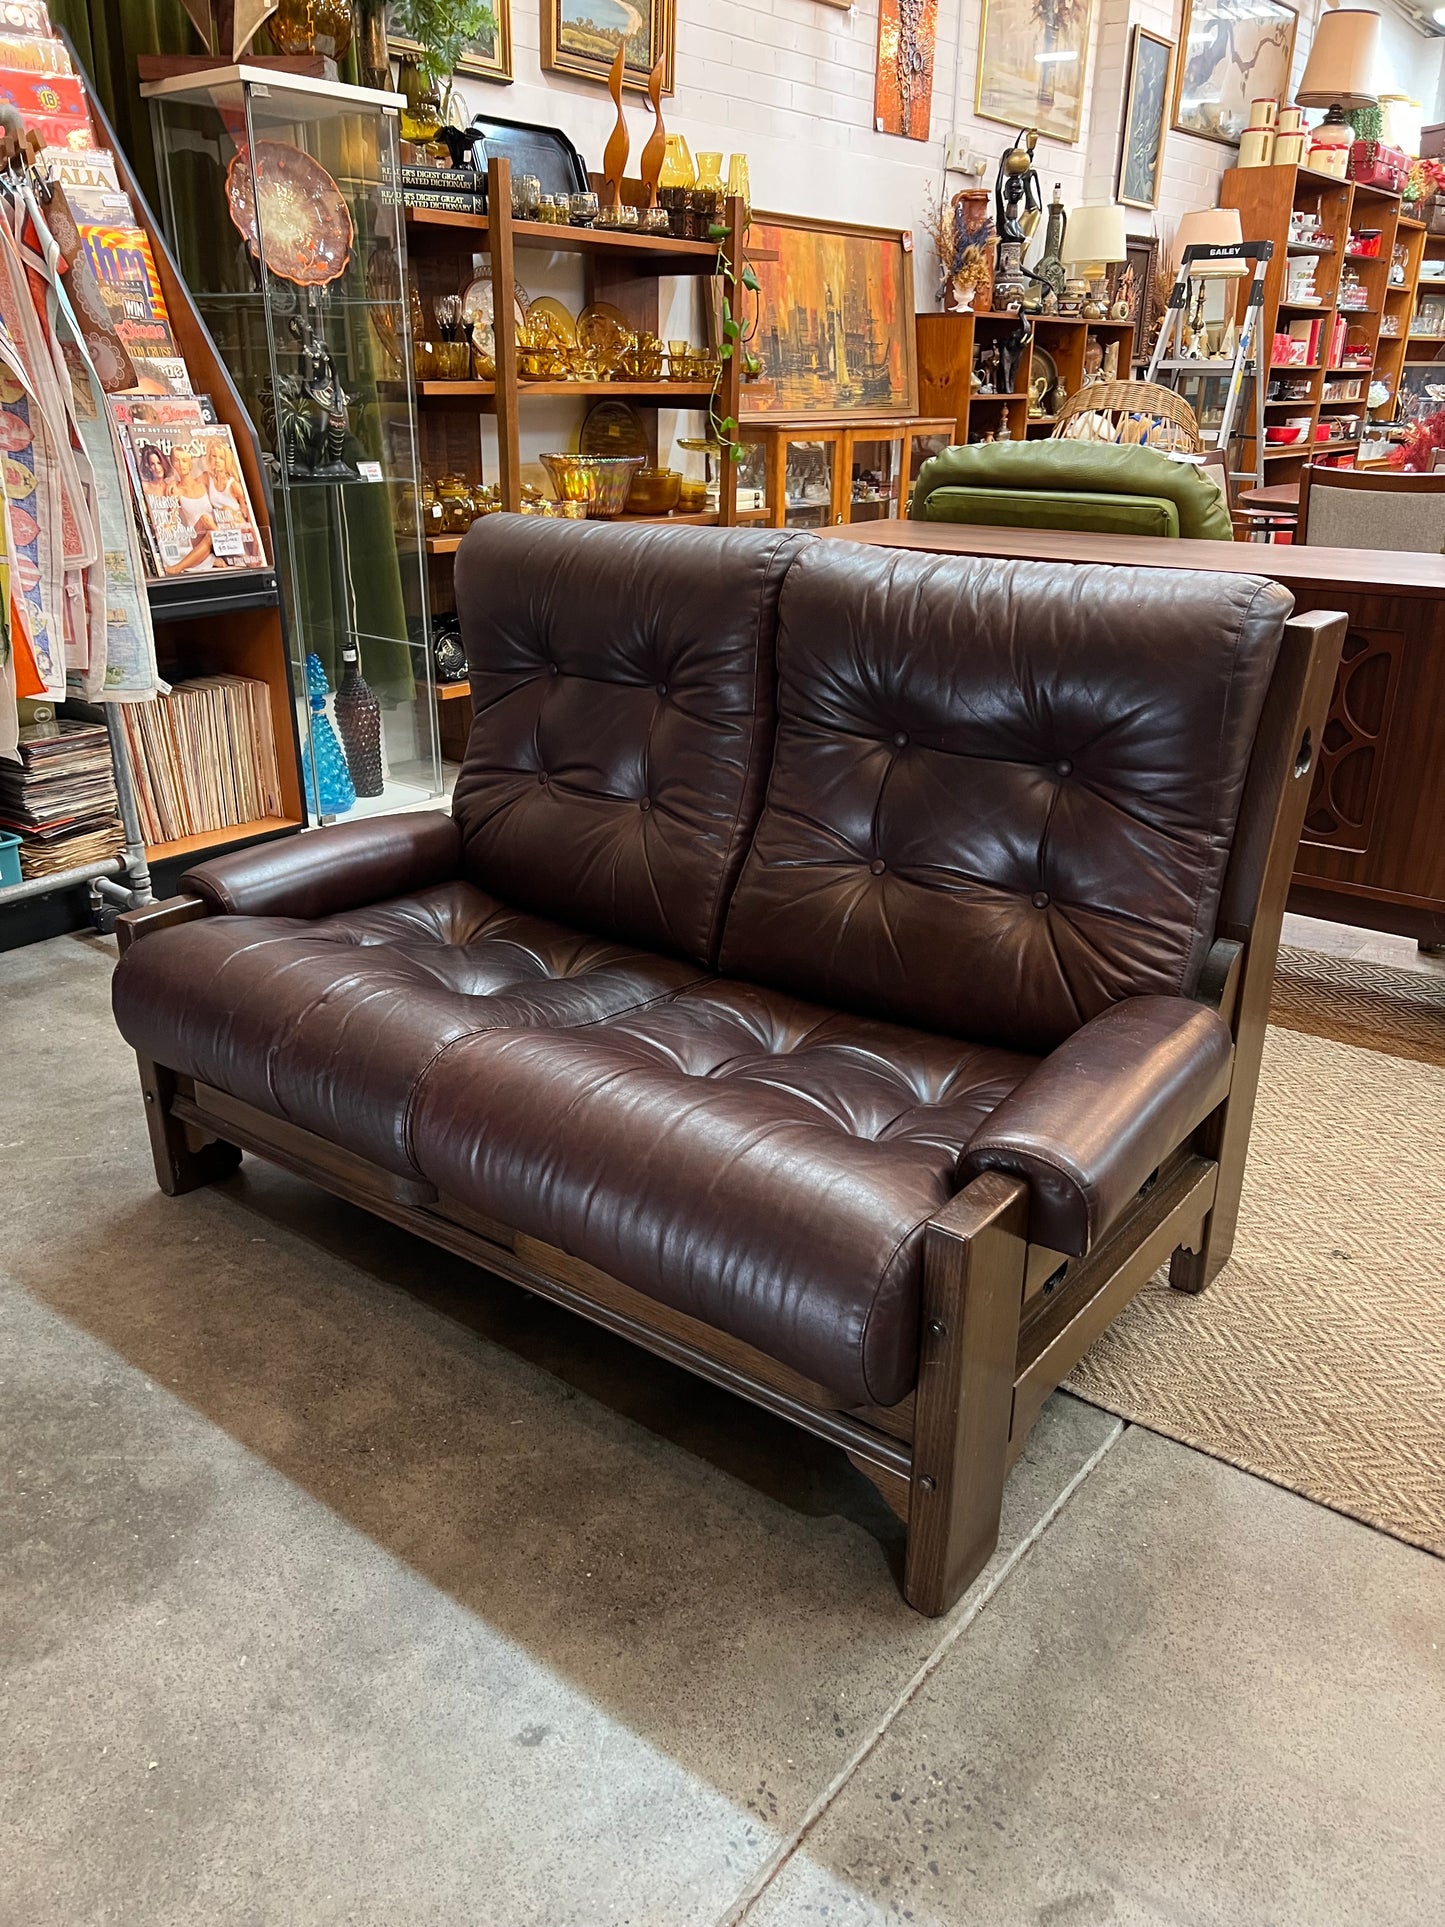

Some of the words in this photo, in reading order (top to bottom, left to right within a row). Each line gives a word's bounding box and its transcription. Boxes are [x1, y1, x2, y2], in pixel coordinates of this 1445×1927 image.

[42, 93, 55, 106] 18
[60, 159, 86, 168] BUILT
[416, 170, 441, 179] DIGEST
[442, 172, 465, 181] GREAT
[430, 179, 472, 190] DICTIONARY
[416, 193, 440, 202] DIGEST
[440, 195, 464, 204] GREAT
[429, 202, 472, 212] DICTIONARY
[1209, 247, 1241, 256] BAILEY
[124, 299, 145, 318] WIN
[128, 345, 145, 358] TOM
[146, 346, 172, 358] CRUISE
